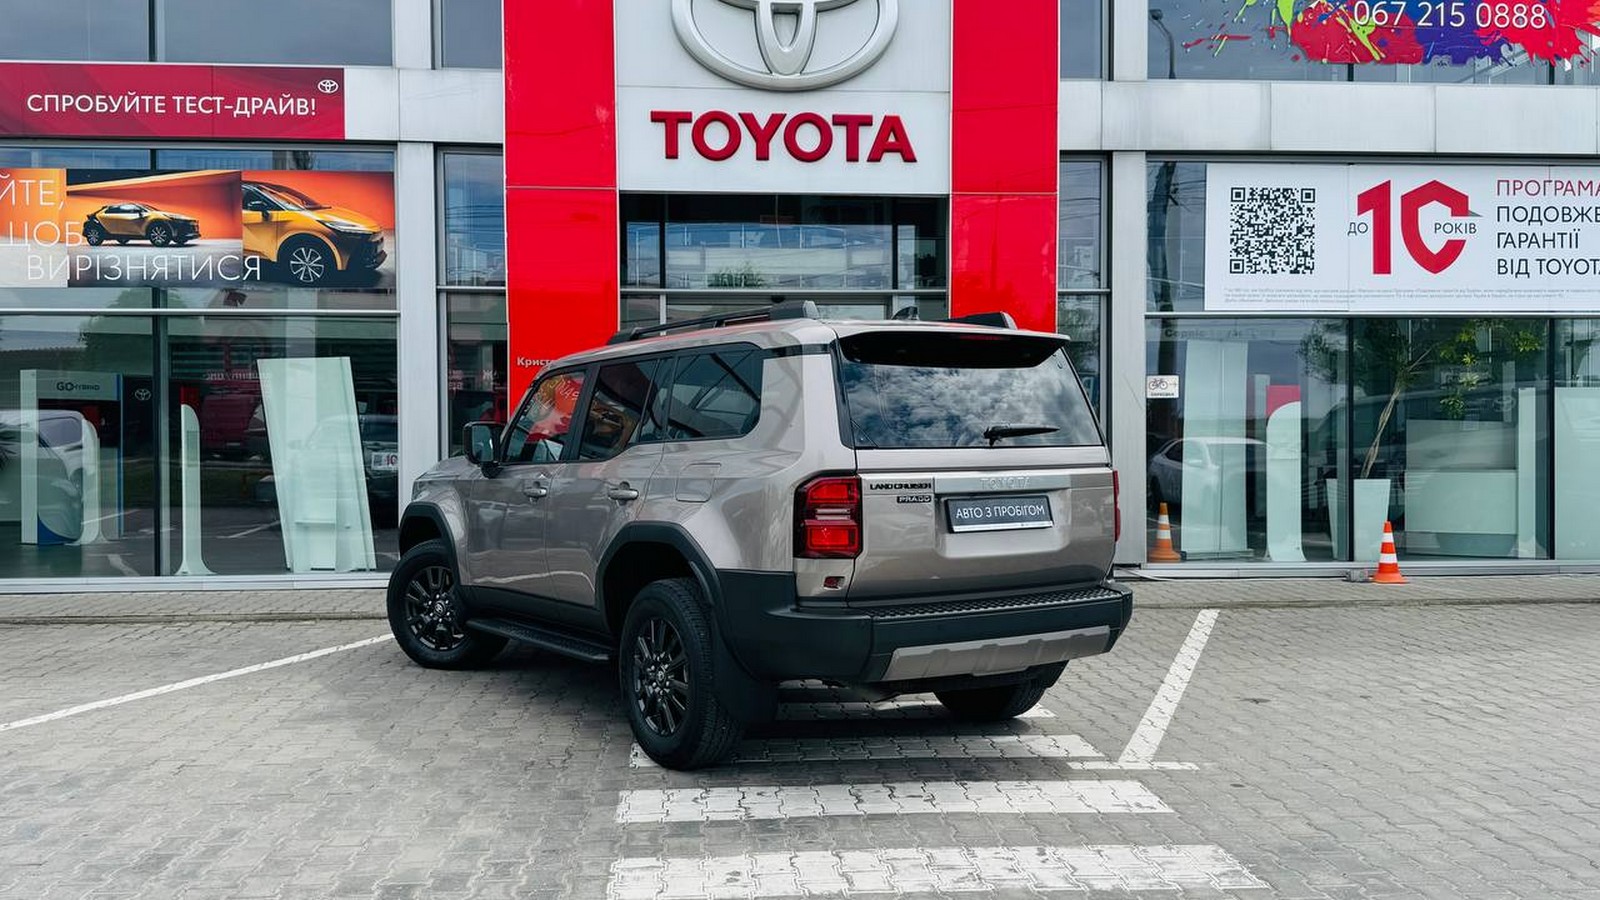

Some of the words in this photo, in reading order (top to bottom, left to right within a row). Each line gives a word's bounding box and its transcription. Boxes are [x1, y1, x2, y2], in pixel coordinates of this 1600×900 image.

[1354, 0, 1407, 27] 067
[1417, 1, 1465, 27] 215
[1476, 3, 1546, 29] 0888
[26, 91, 166, 114] СПРОБУЙТЕ
[172, 93, 317, 118] ТЕСТ-ДРАЙВ!
[650, 110, 917, 163] TOYOTA
[1347, 222, 1369, 236] ДО
[1434, 222, 1477, 234] РОКІВ
[1497, 228, 1581, 249] ГАРАНТІЇ
[27, 254, 262, 282] ВИРІЗНЯТИСЯ
[1497, 258, 1530, 279] ВІД
[1536, 258, 1600, 275] TOYOT
[980, 476, 1030, 490] TOYOTA
[956, 507, 984, 519] АВТО
[993, 504, 1045, 517] ПРОБІГОМ
